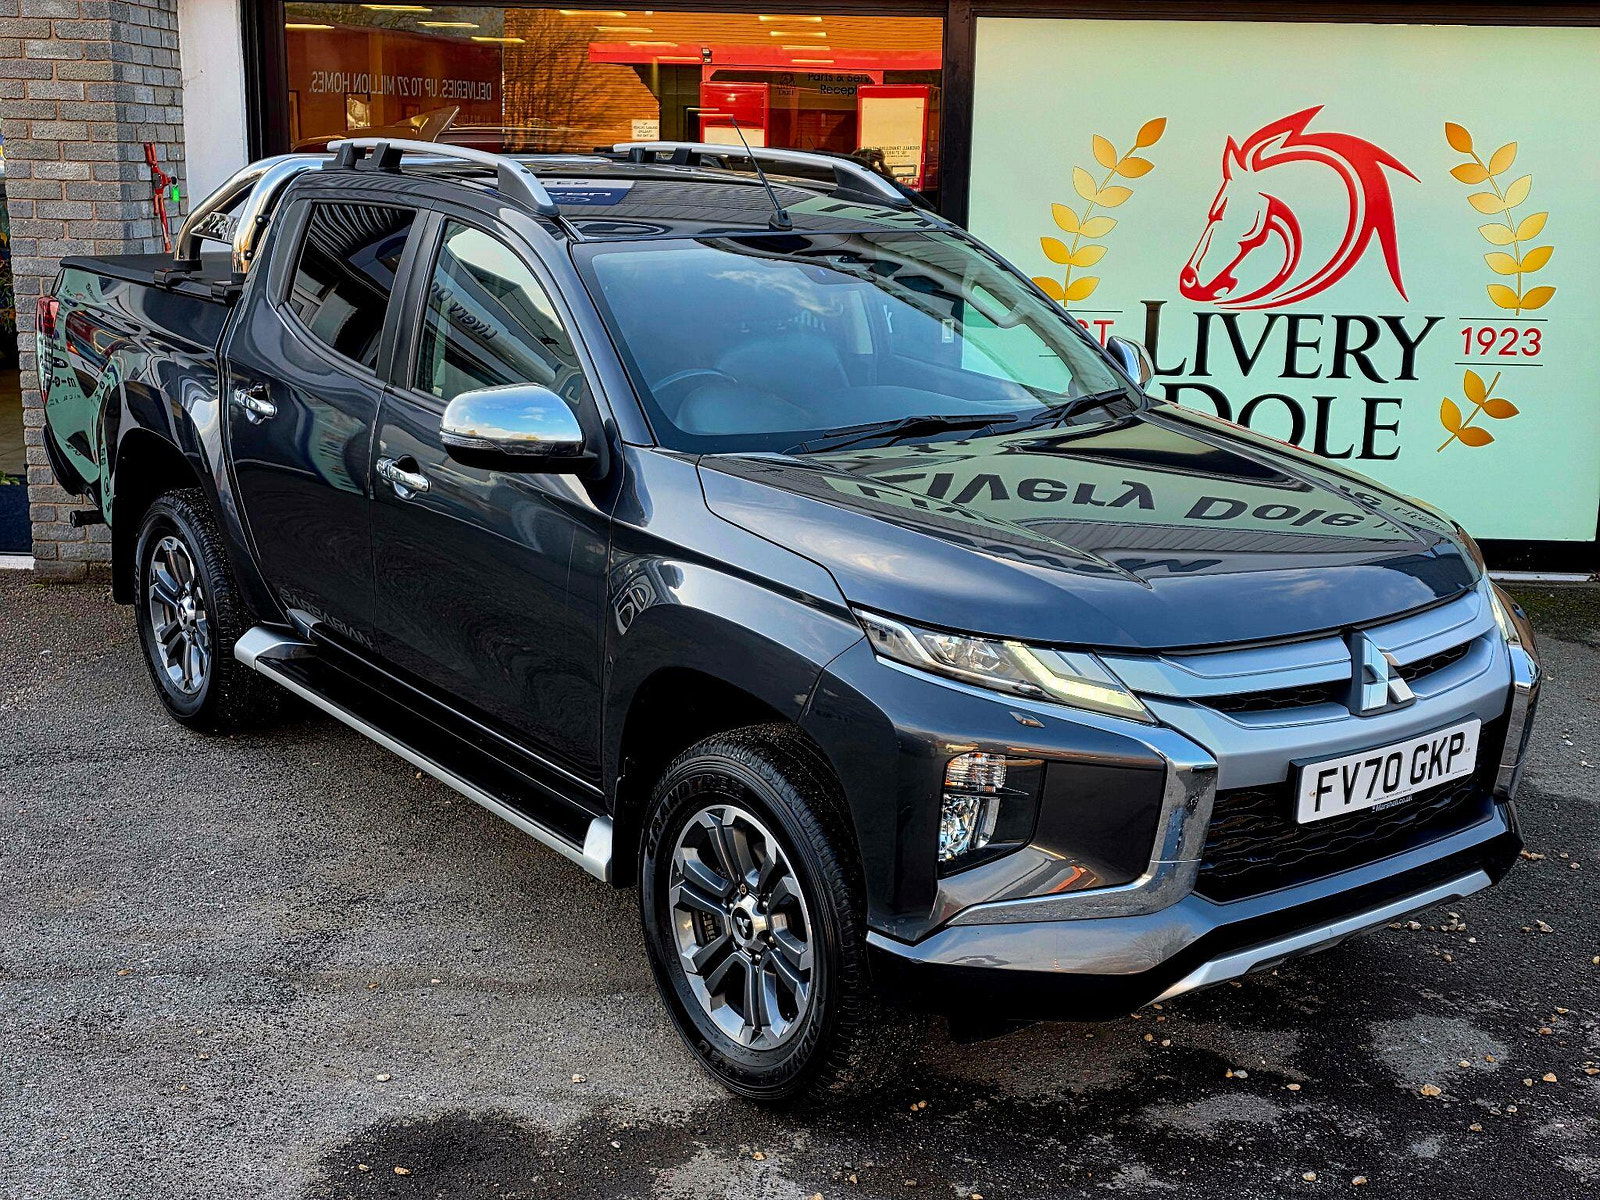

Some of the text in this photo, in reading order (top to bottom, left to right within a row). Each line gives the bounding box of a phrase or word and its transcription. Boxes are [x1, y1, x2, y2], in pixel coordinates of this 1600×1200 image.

[1140, 300, 1445, 384] LIVERY
[1461, 326, 1543, 357] 1923
[1315, 731, 1466, 813] FV70 GKP
